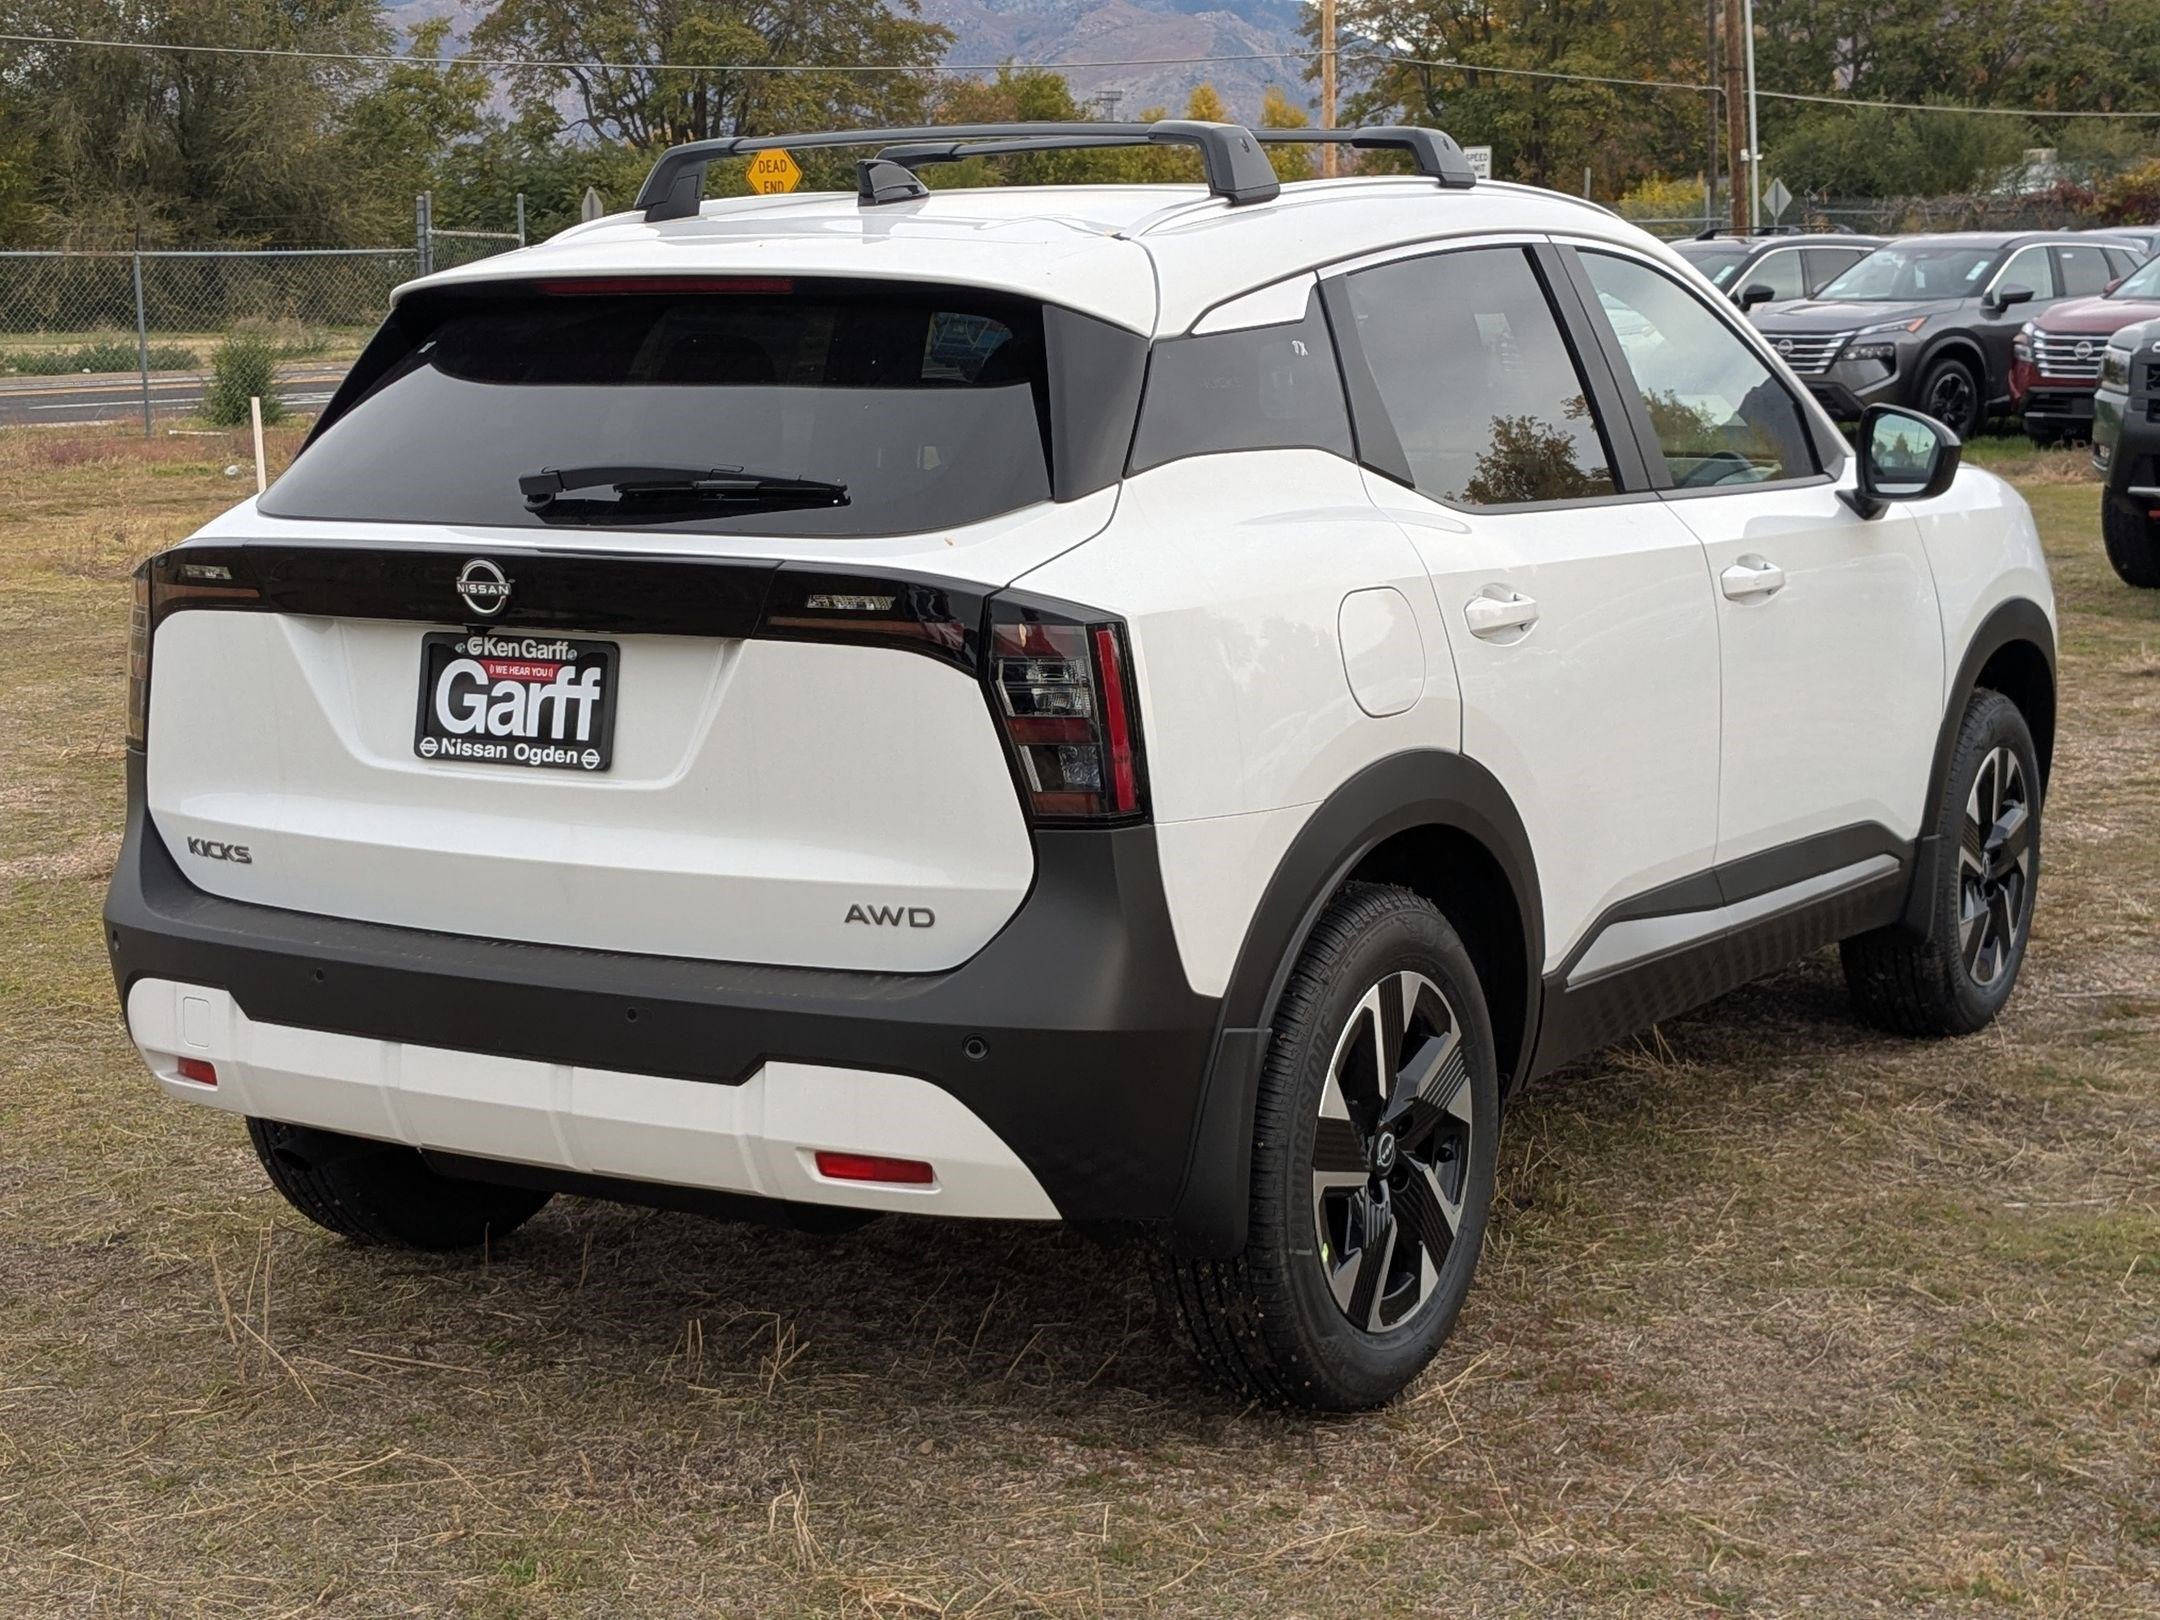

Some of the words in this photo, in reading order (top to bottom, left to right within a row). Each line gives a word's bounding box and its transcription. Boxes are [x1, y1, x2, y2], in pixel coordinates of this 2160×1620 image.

[758, 160, 787, 174] DEAD
[763, 181, 785, 193] END
[457, 583, 510, 595] NISSAN
[484, 637, 520, 658] Ken
[521, 639, 569, 660] Garff
[495, 665, 508, 674] WE
[509, 666, 531, 676] HEAR
[532, 667, 548, 677] YOU
[435, 658, 601, 741] Garff
[441, 738, 508, 758] Nissan
[514, 743, 578, 765] Ogden
[187, 836, 252, 864] KICKS
[844, 904, 936, 928] AWD
